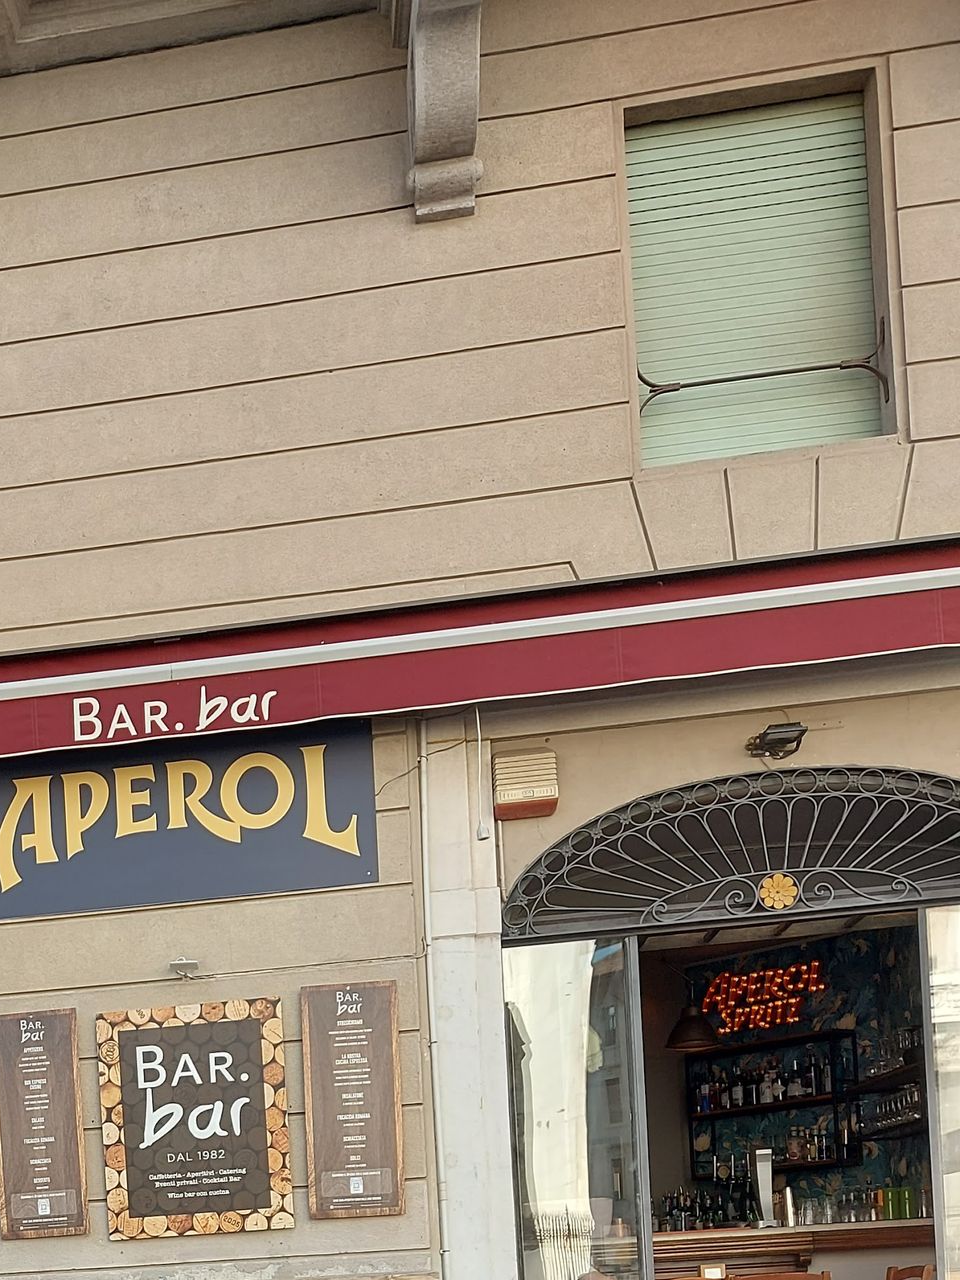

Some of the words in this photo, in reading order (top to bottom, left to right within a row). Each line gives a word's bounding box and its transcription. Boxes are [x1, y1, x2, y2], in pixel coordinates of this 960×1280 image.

[72, 696, 184, 741] BAR.
[195, 685, 278, 733] bar
[336, 1001, 362, 1016] bar
[702, 960, 826, 1014] APEROL
[21, 1030, 45, 1043] bar
[135, 1044, 250, 1090] BAR.
[139, 1087, 251, 1150] bar
[167, 1152, 193, 1163] DAL
[197, 1149, 226, 1160] 1982
